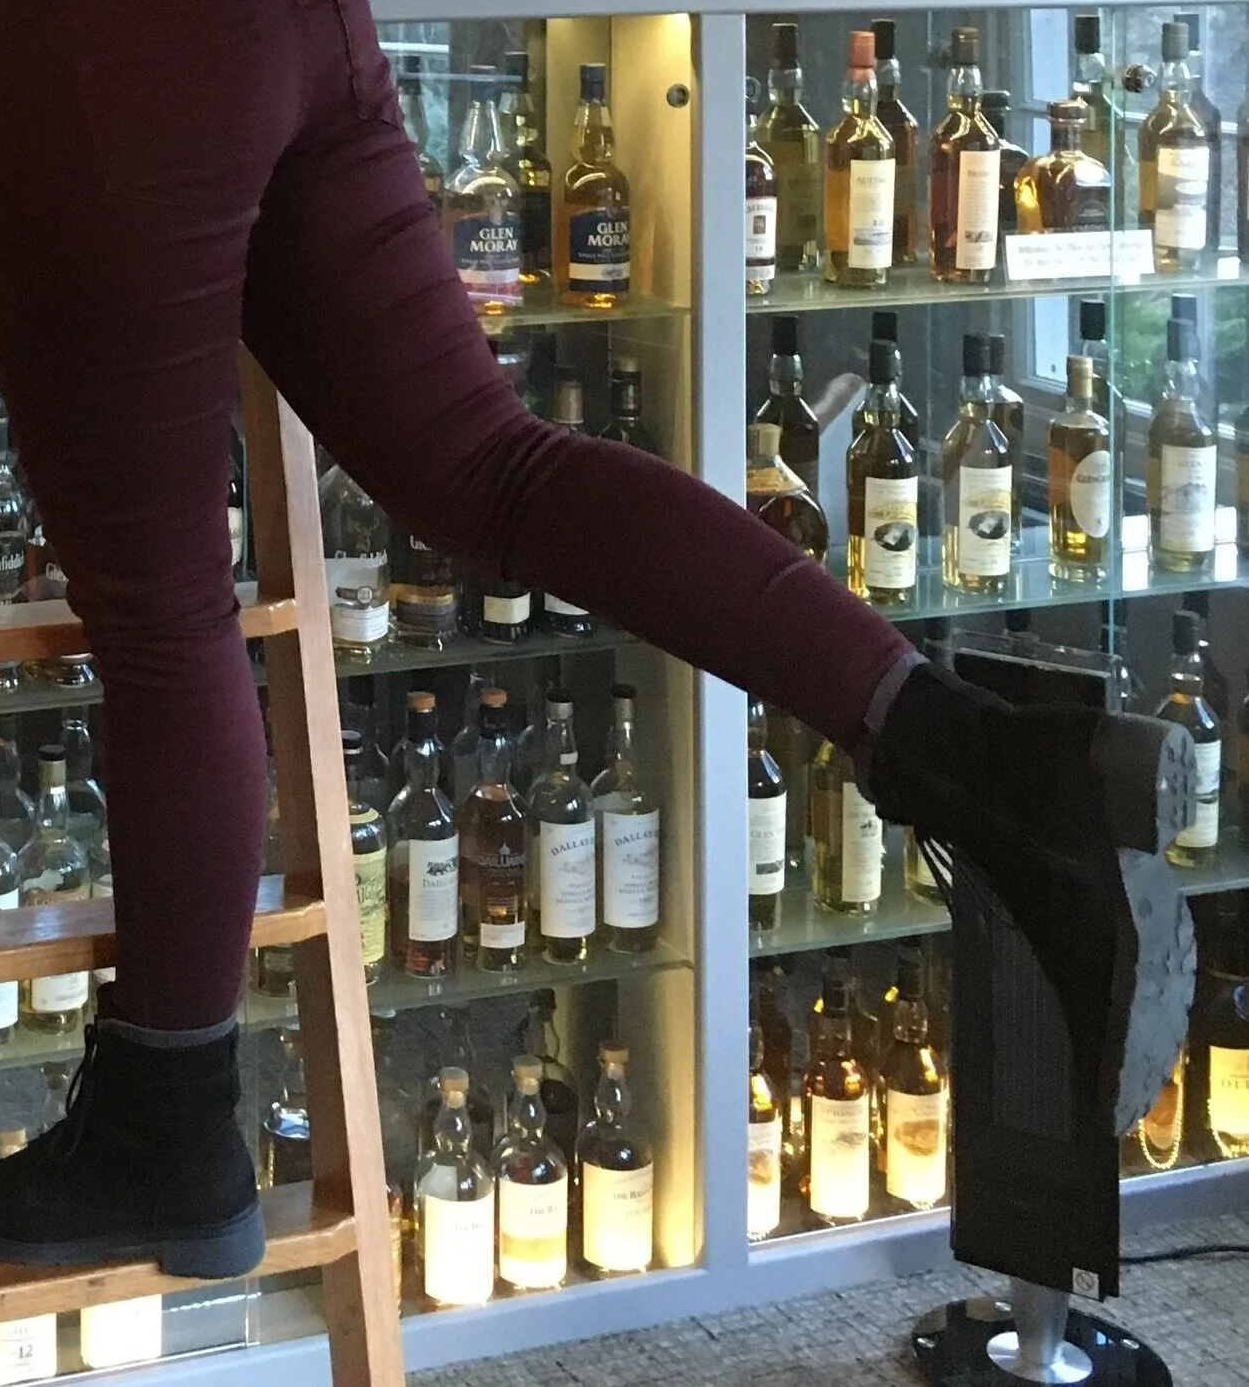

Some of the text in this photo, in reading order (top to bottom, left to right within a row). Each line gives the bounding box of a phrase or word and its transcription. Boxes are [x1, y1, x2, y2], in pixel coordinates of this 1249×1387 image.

[478, 226, 514, 241] GLEN
[596, 220, 628, 235] GLEN
[469, 239, 518, 253] MORAY
[17, 1344, 34, 1360] 12
